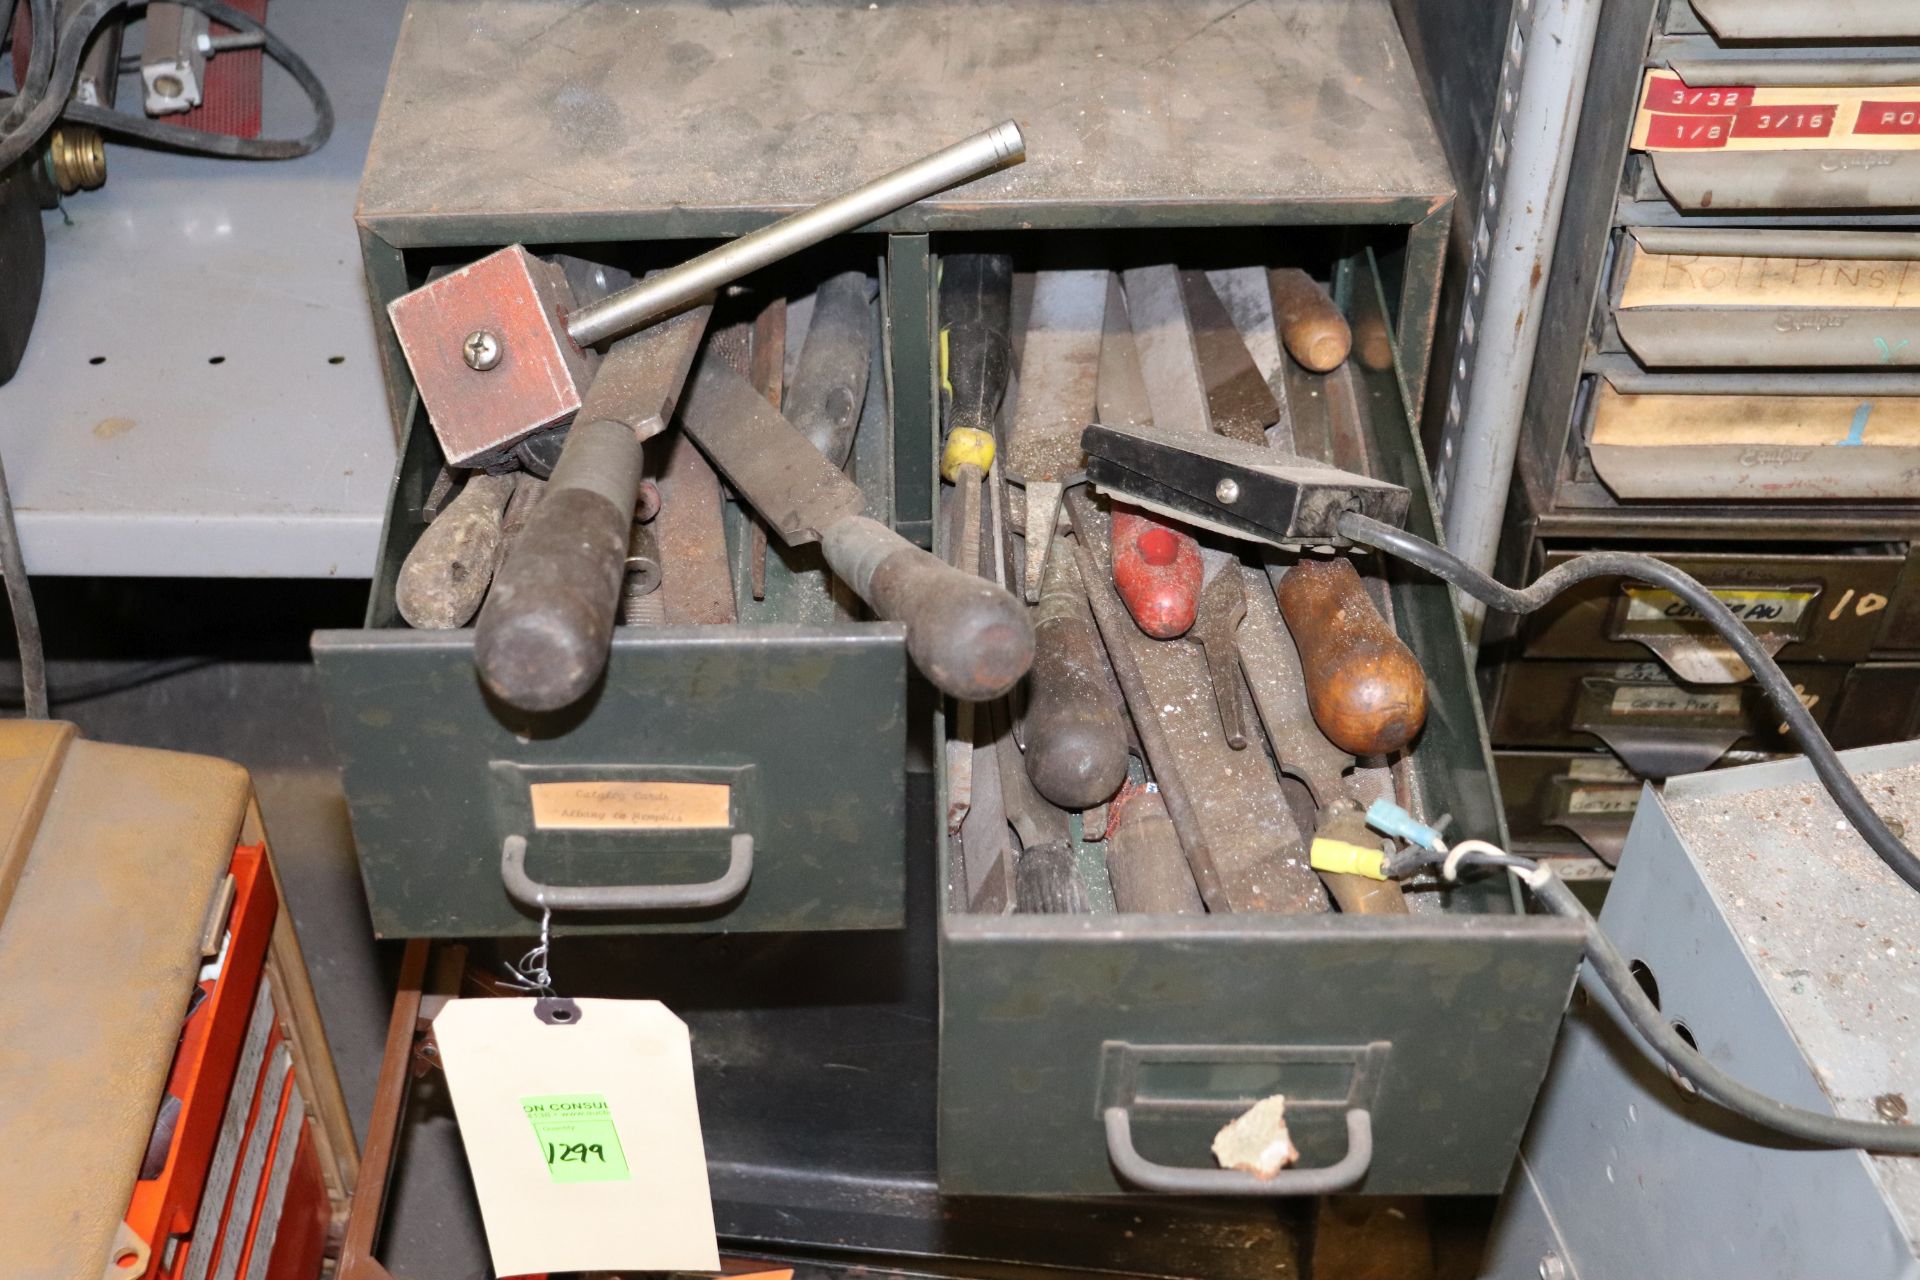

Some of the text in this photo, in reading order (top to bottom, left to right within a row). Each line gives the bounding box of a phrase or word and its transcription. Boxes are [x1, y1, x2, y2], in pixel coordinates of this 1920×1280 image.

[1671, 90, 1740, 107] 3/32
[1756, 114, 1824, 129] 3/16
[1880, 111, 1920, 126] RO
[1675, 125, 1722, 139] 1/8
[1828, 588, 1888, 621] 10
[523, 1104, 545, 1113] ON
[547, 1141, 606, 1165] 1299
